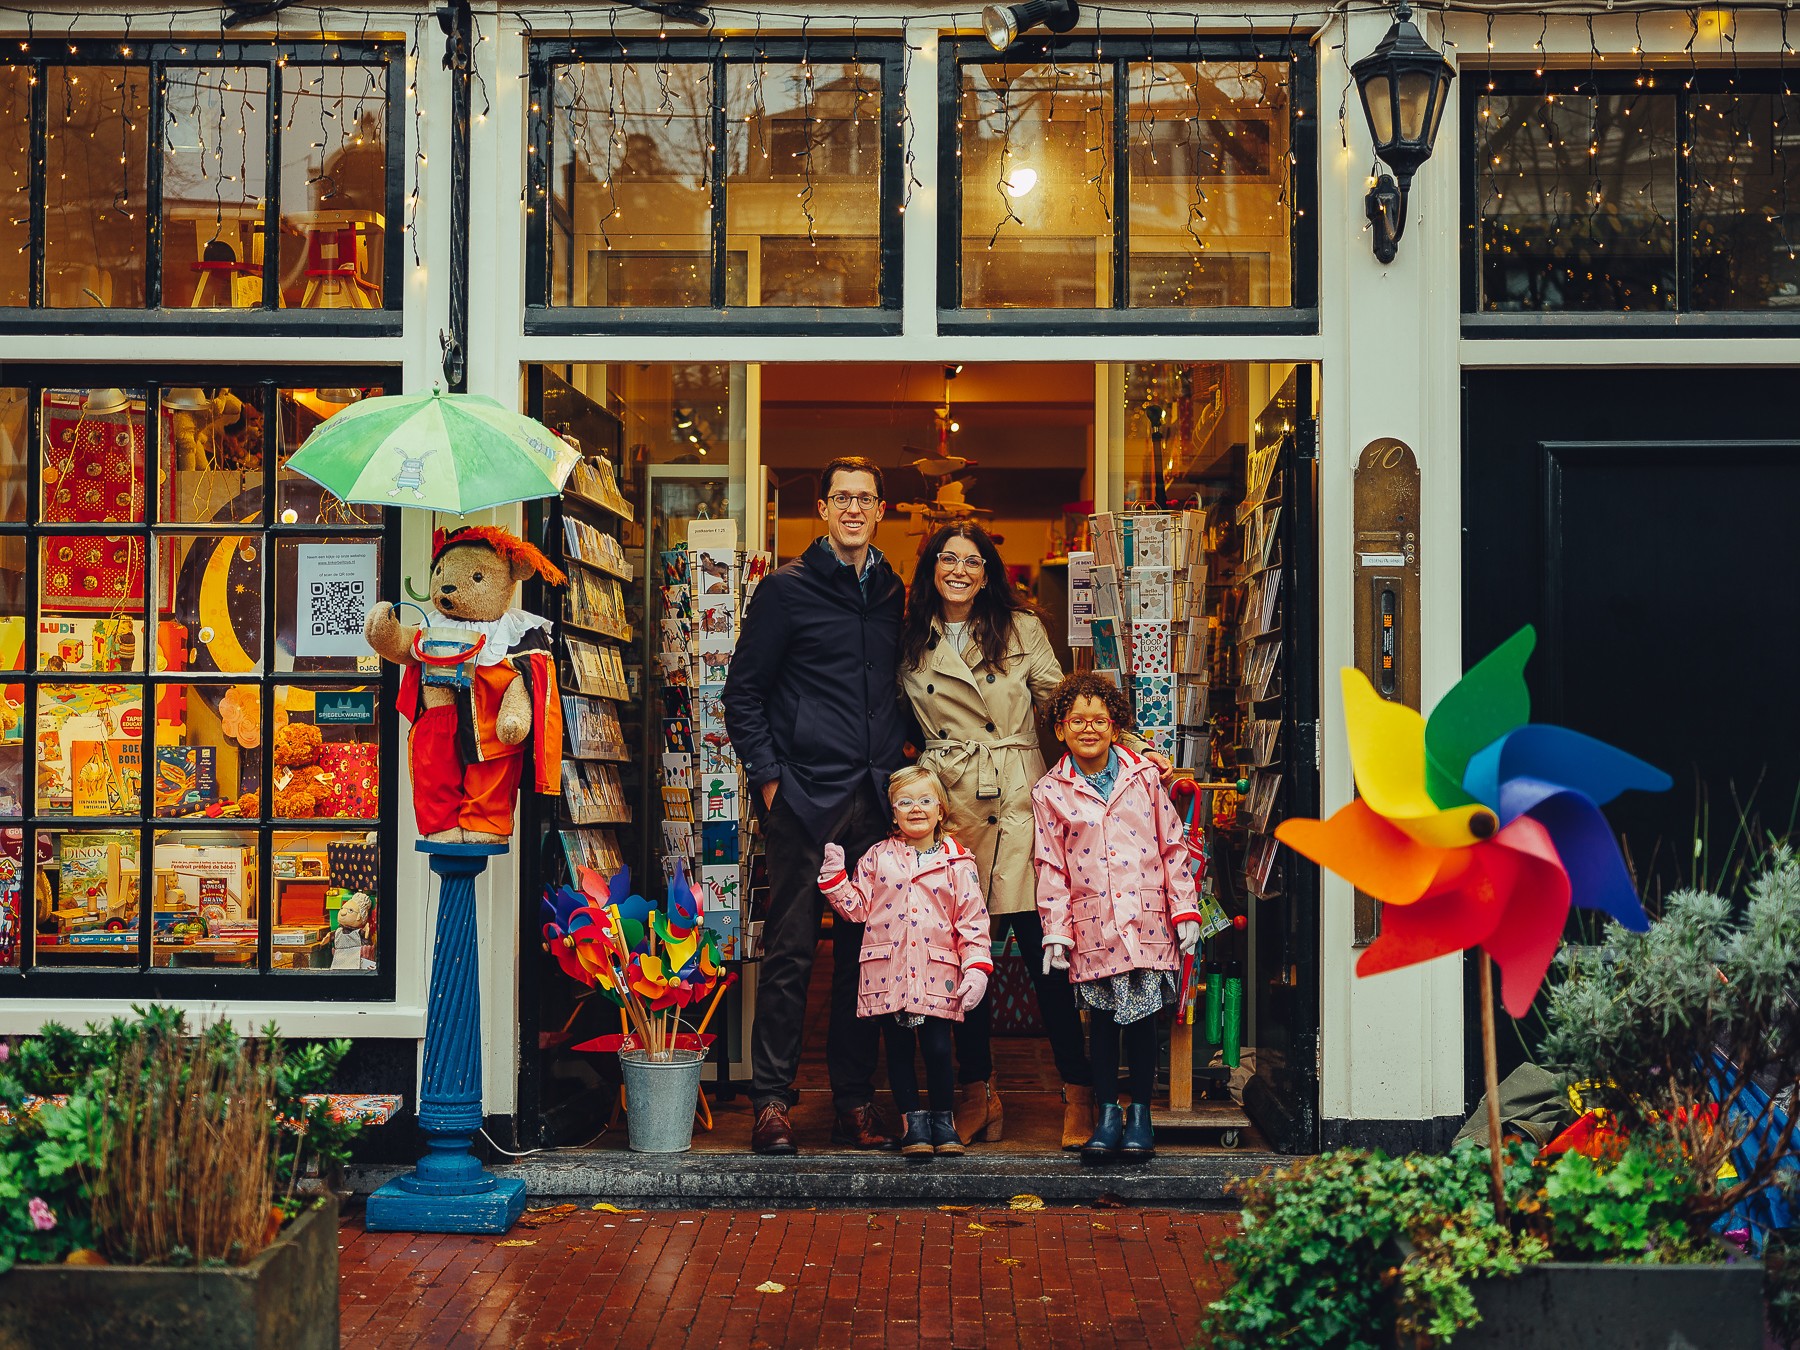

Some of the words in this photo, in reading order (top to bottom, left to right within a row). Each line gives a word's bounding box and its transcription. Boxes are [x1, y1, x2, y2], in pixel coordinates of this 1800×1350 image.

[1367, 446, 1404, 469] 10
[1384, 614, 1392, 627] NEE
[1383, 655, 1392, 668] NEE
[118, 755, 140, 764] BORI
[664, 827, 689, 835] HELLO
[666, 836, 690, 852] BABY
